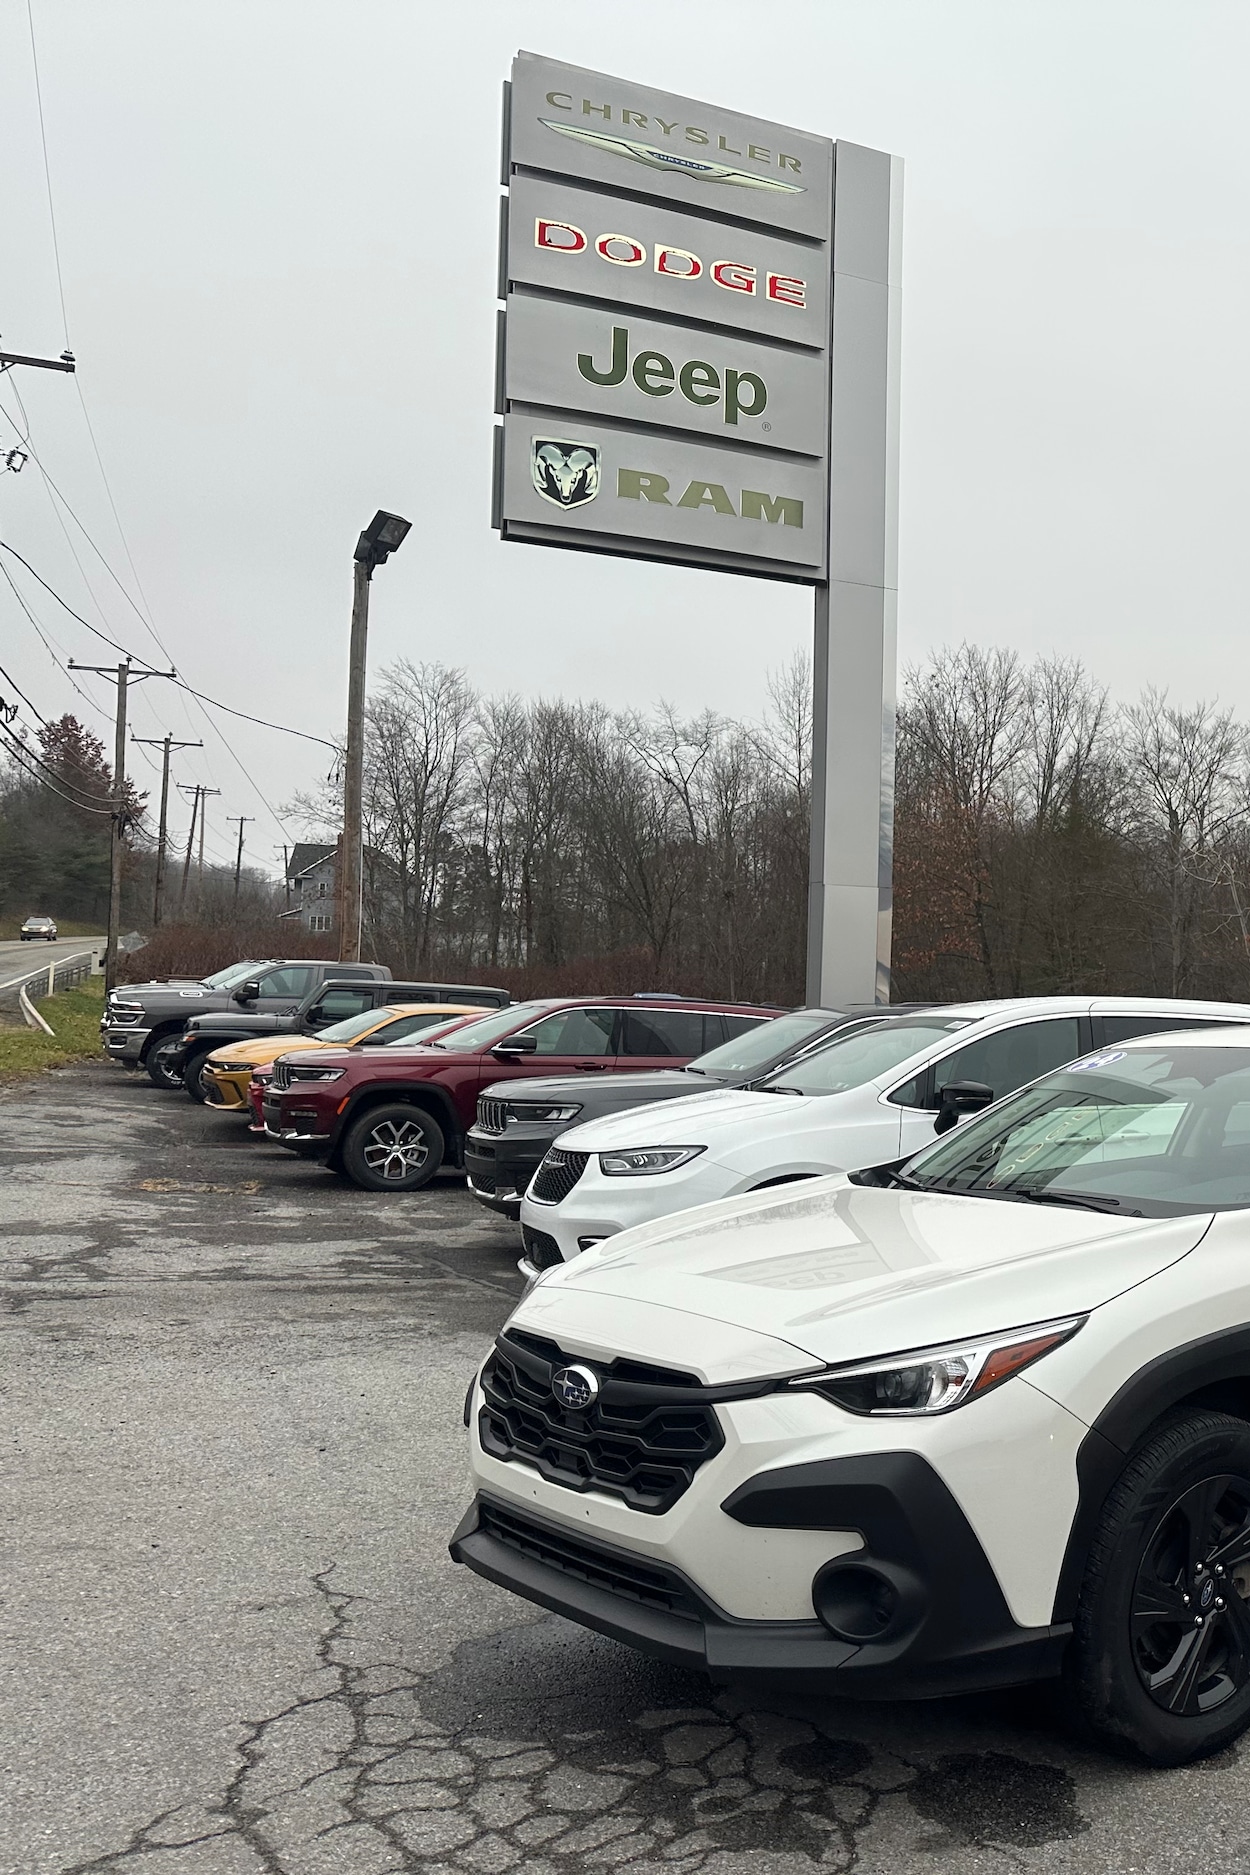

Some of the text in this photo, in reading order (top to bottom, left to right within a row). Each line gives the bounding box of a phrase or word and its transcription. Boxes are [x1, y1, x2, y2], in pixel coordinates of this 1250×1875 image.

[545, 91, 803, 174] CHRYSLER
[653, 153, 705, 170] CHRYSLER
[535, 217, 807, 309] DODGE
[577, 326, 768, 425] Jeep
[616, 467, 804, 529] RAM
